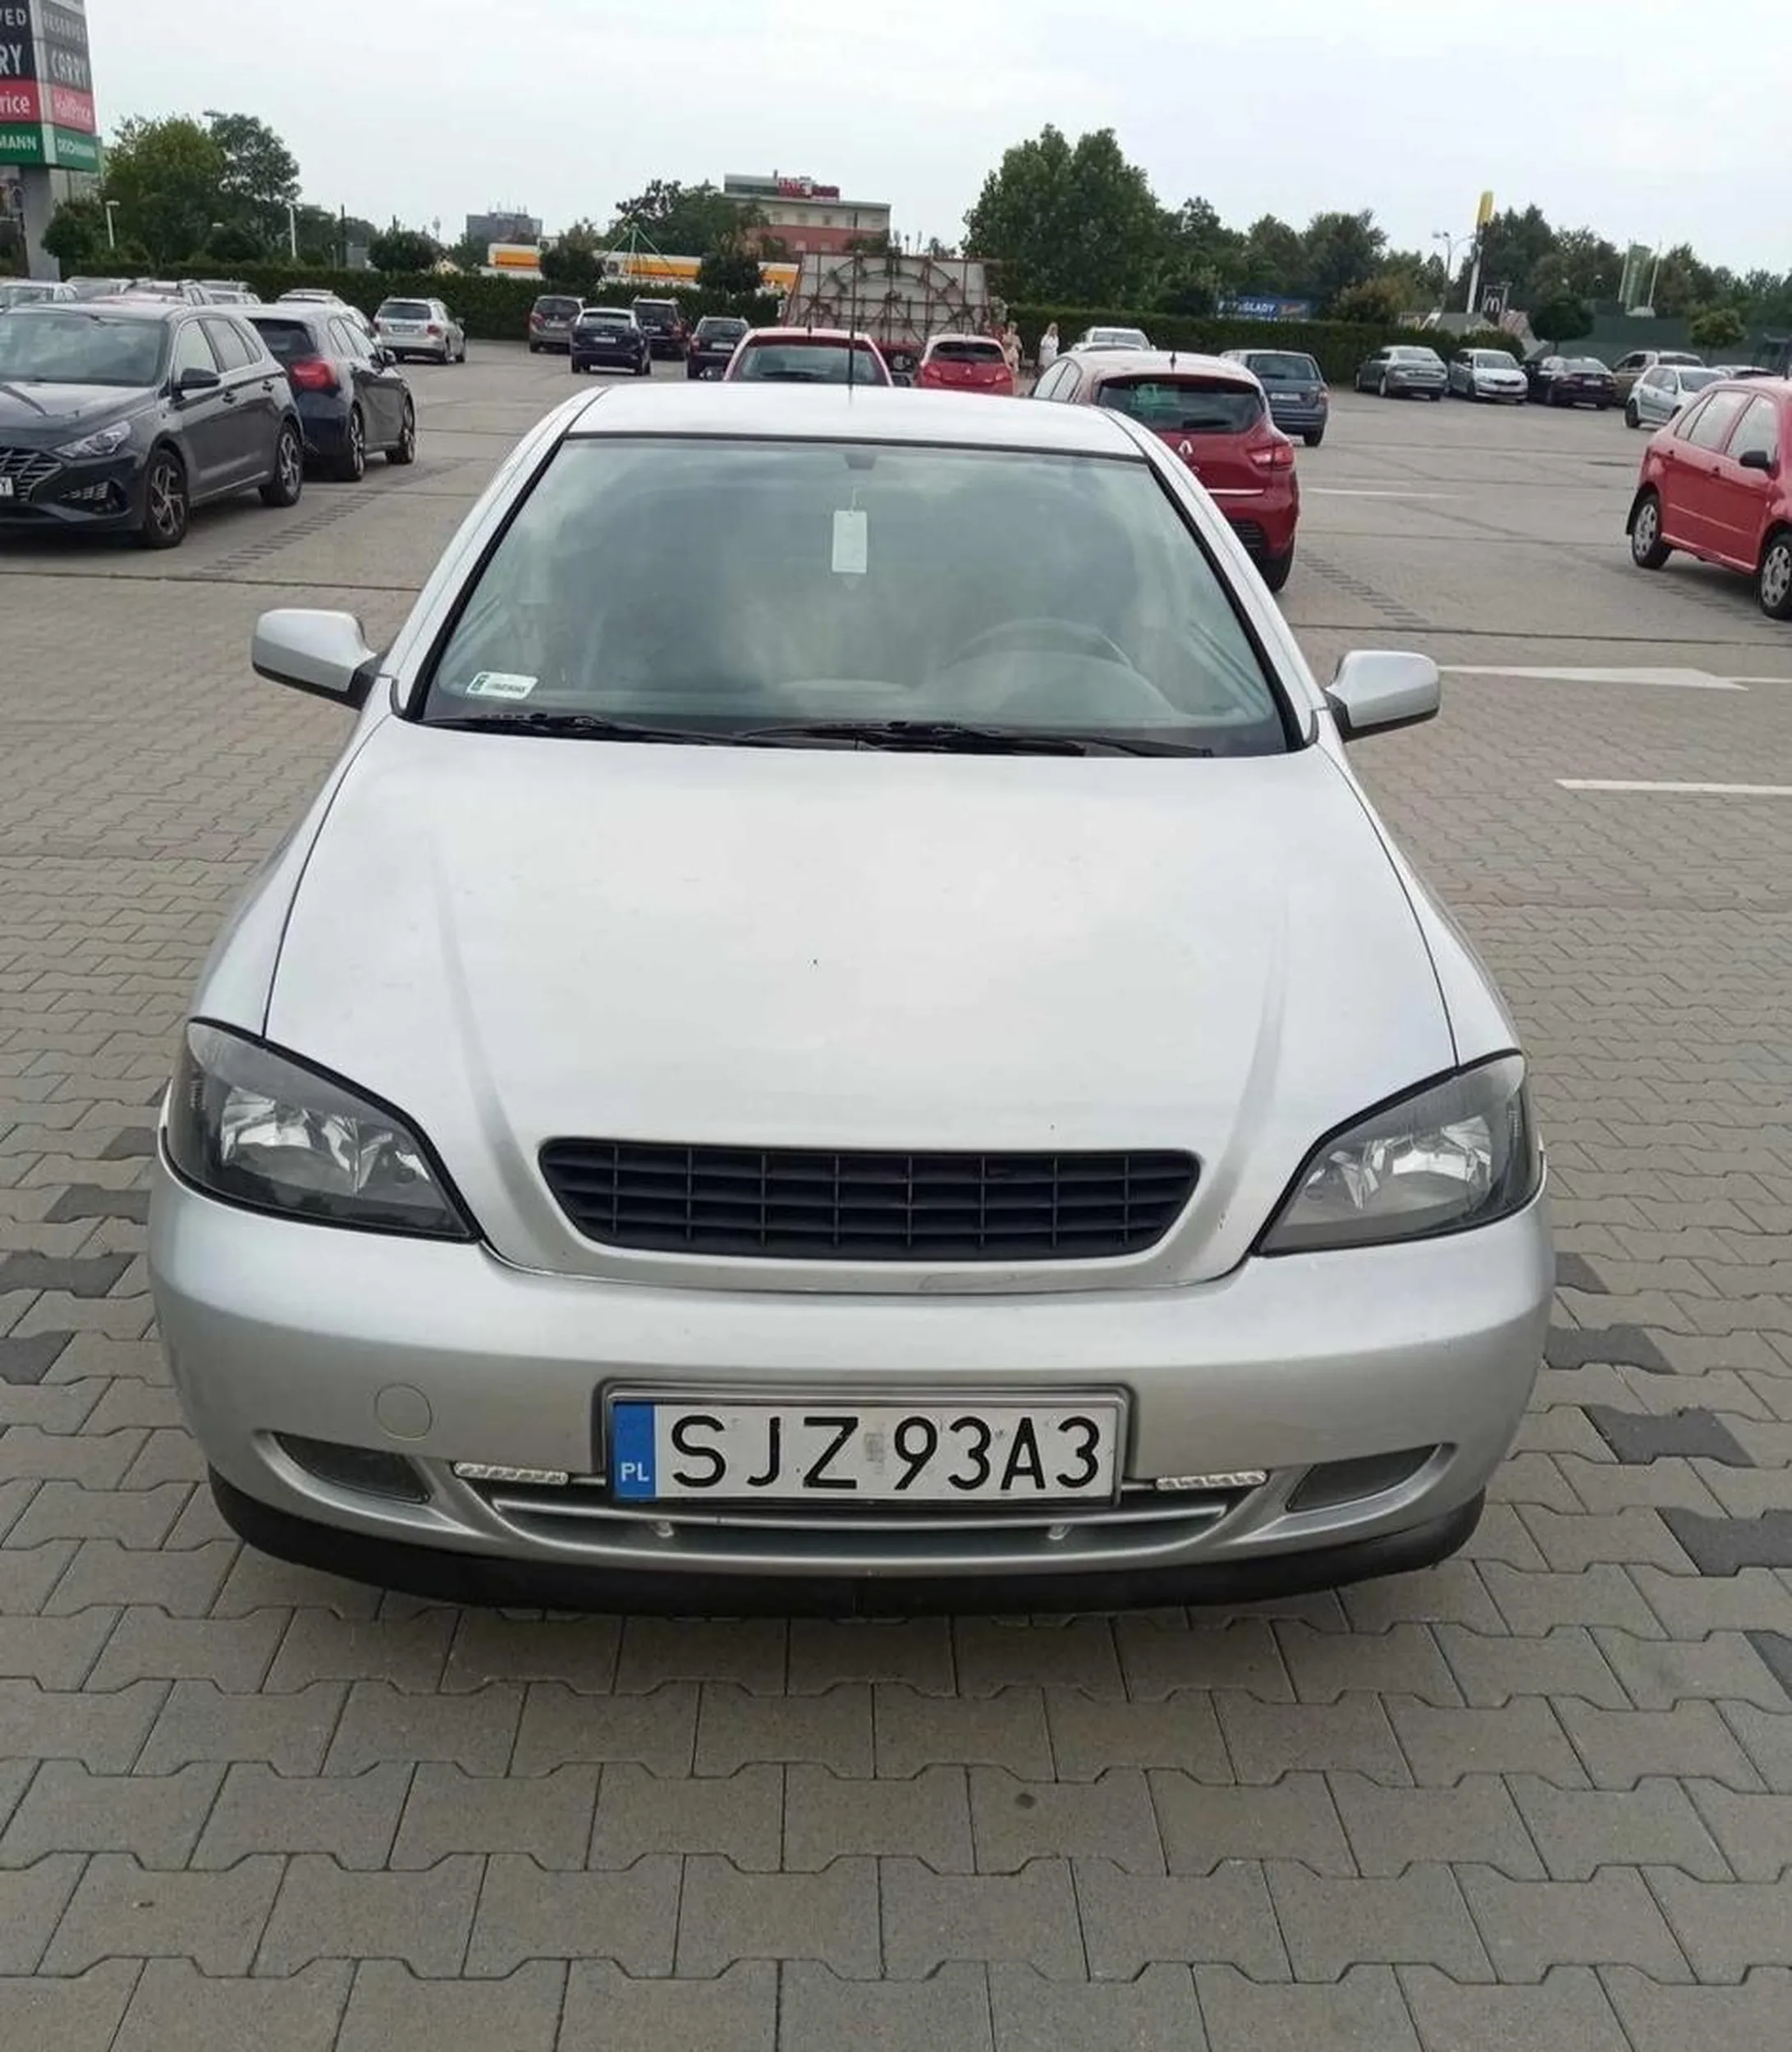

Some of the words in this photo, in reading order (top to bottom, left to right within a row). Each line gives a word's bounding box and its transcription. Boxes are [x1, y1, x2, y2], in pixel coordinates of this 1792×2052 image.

[621, 1461, 650, 1482] PL
[671, 1415, 859, 1490] SJZ
[894, 1416, 1101, 1491] 93A3
